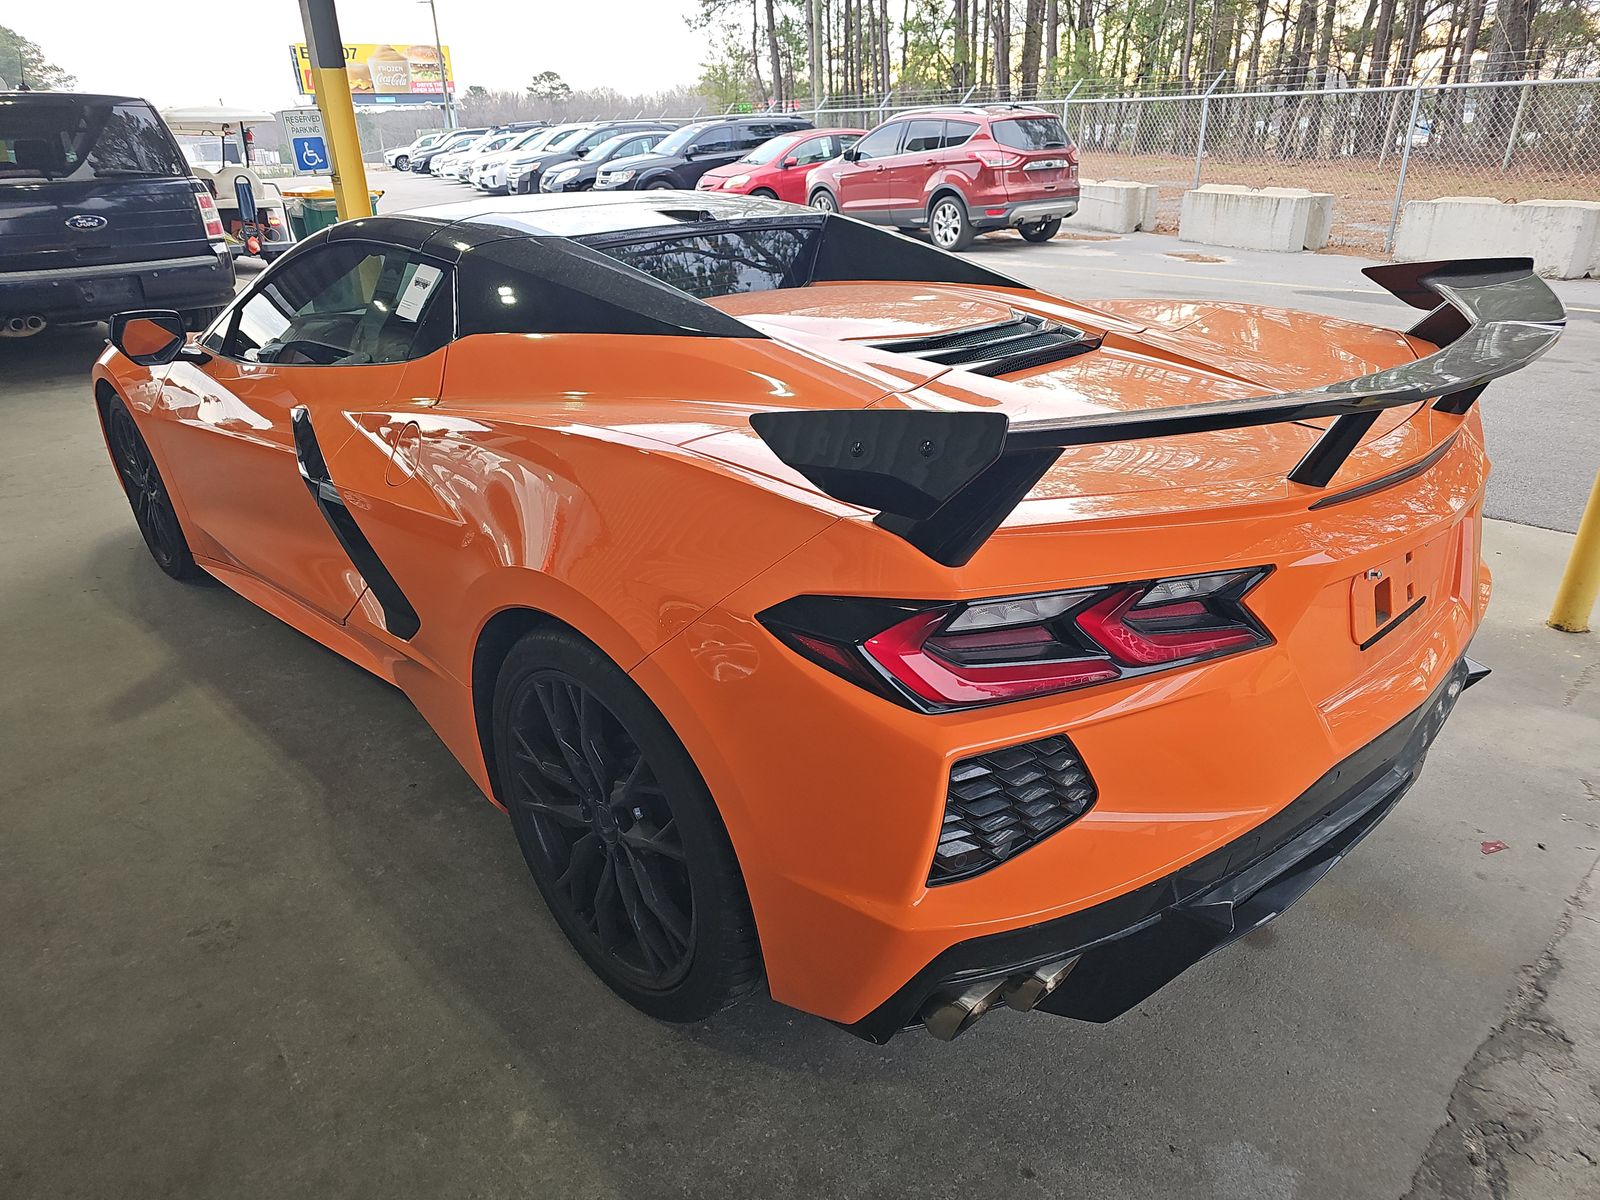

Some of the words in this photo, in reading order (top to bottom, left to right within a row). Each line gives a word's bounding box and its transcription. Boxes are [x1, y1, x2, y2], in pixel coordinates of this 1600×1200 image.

[378, 65, 403, 73] FROZEN
[285, 115, 320, 126] RESERVED
[291, 126, 320, 134] PARKING
